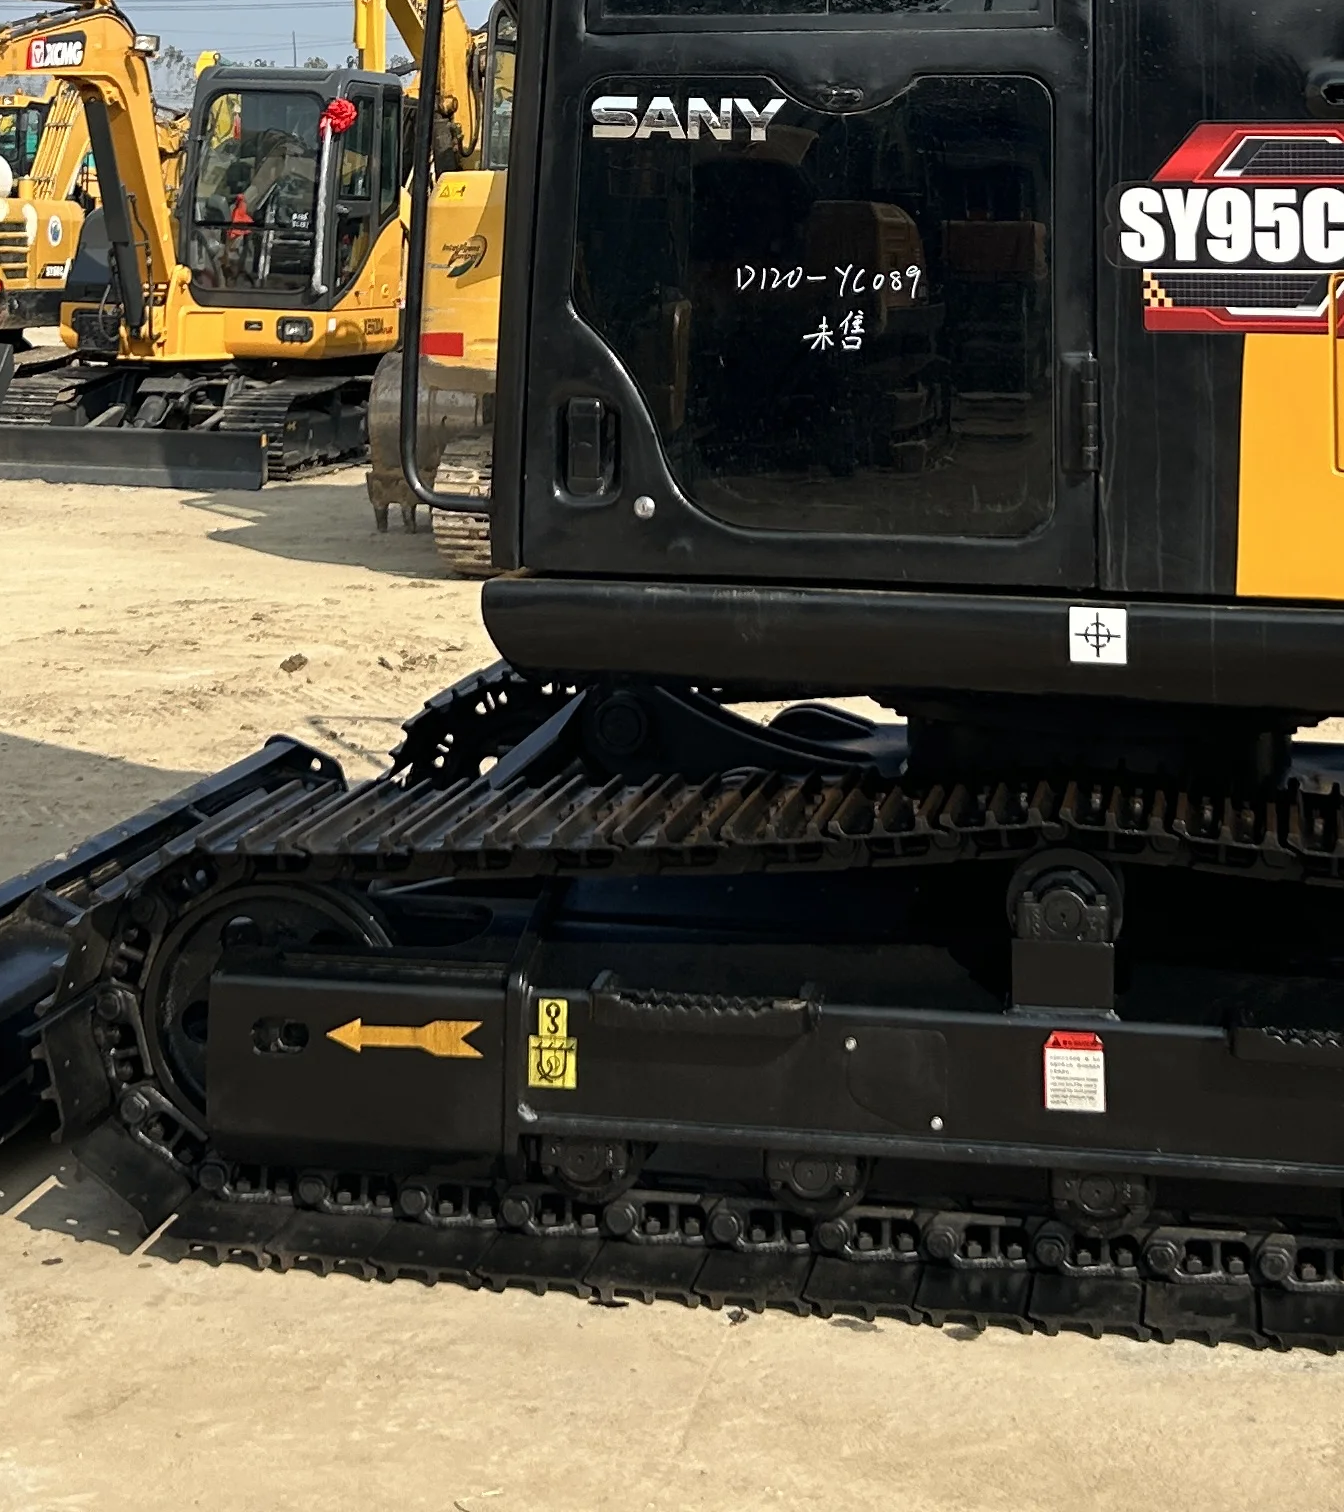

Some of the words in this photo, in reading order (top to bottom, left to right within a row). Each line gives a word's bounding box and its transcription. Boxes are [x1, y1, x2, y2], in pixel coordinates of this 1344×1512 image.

[44, 40, 84, 67] XCMG
[590, 95, 787, 141] SANY
[802, 309, 866, 351] 未售
